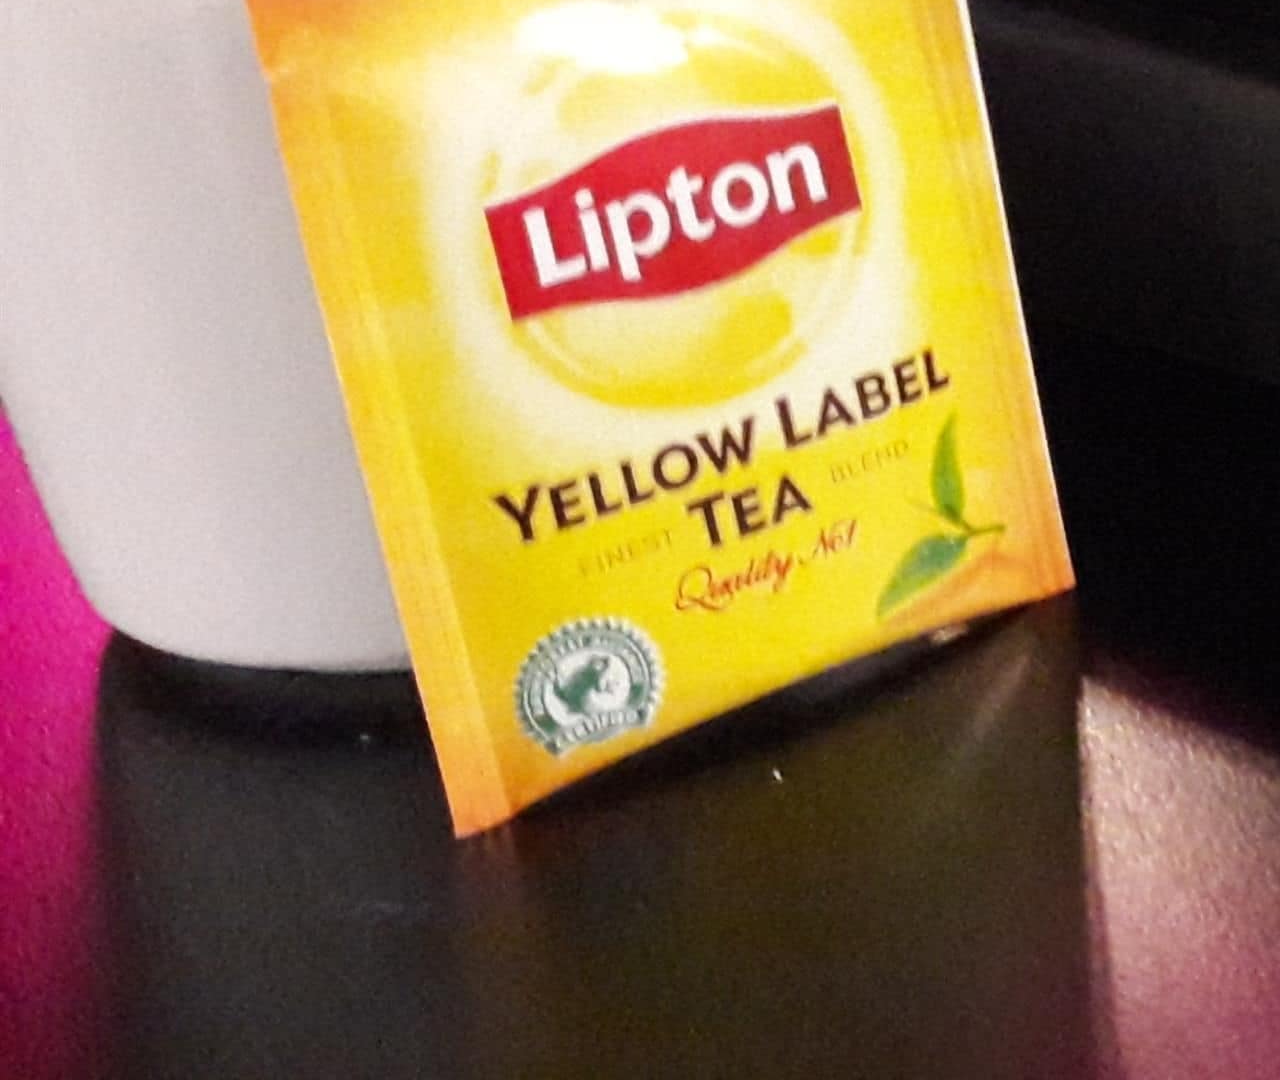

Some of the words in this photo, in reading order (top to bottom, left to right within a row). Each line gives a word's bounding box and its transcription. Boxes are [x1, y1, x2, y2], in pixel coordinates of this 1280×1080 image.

[519, 139, 830, 290] Lipton
[685, 473, 813, 548] TEA
[674, 549, 794, 612] Quality
